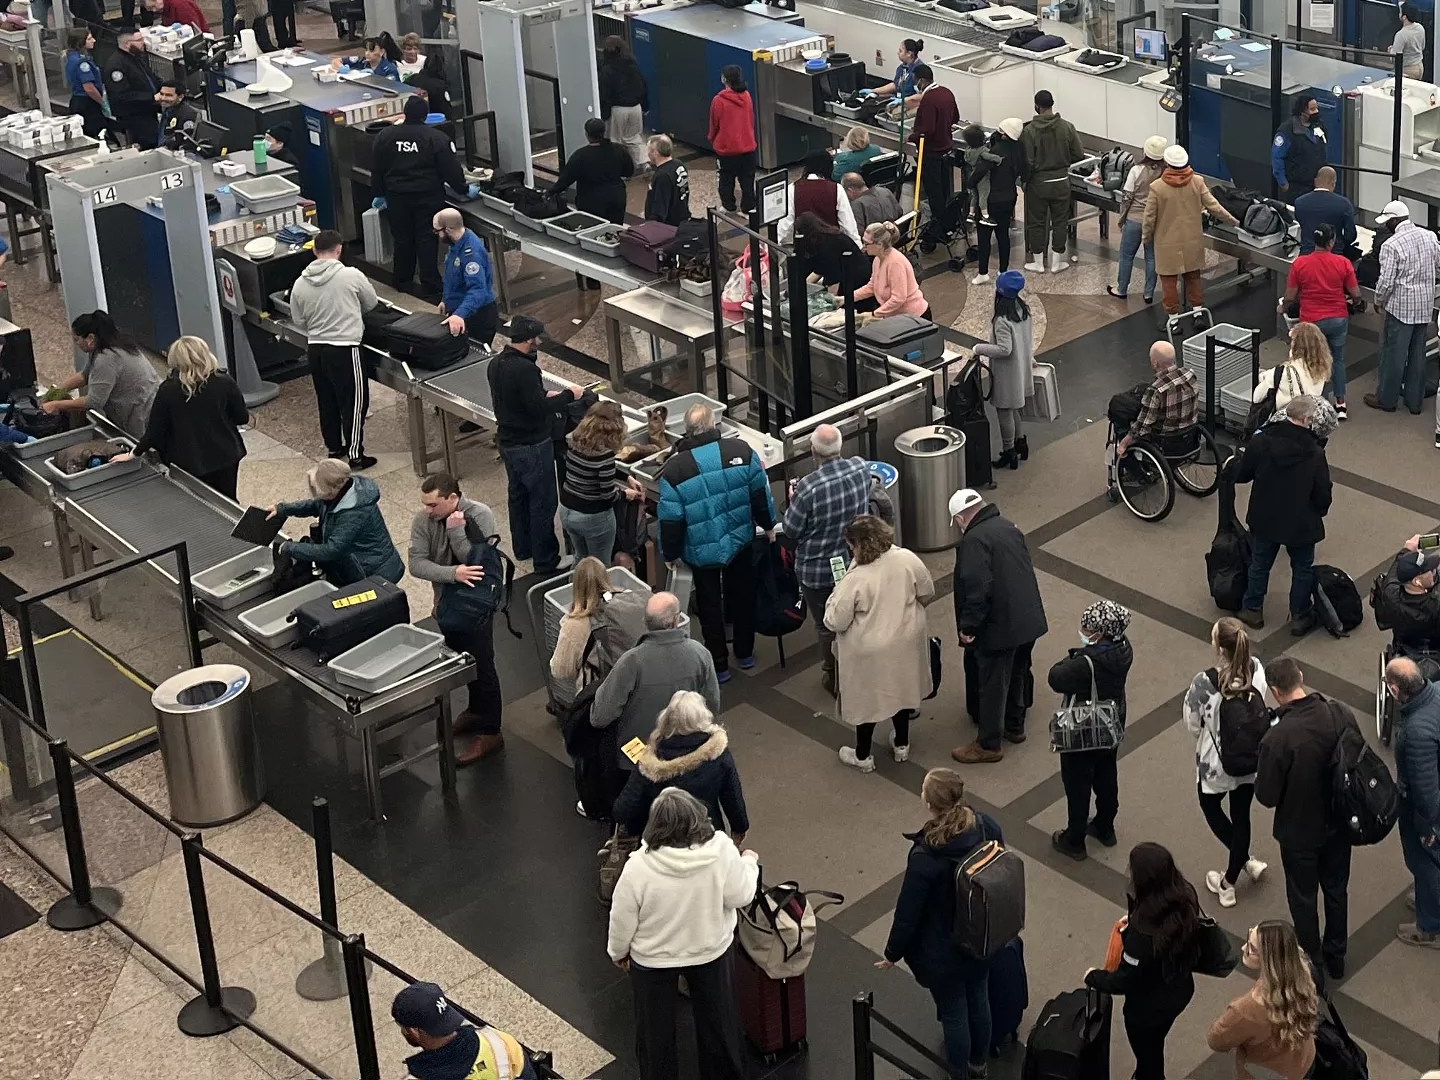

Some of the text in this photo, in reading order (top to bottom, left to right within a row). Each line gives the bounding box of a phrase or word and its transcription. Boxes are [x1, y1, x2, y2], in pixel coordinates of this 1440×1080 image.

[396, 141, 419, 153] TSA
[94, 172, 184, 205] 14 13
